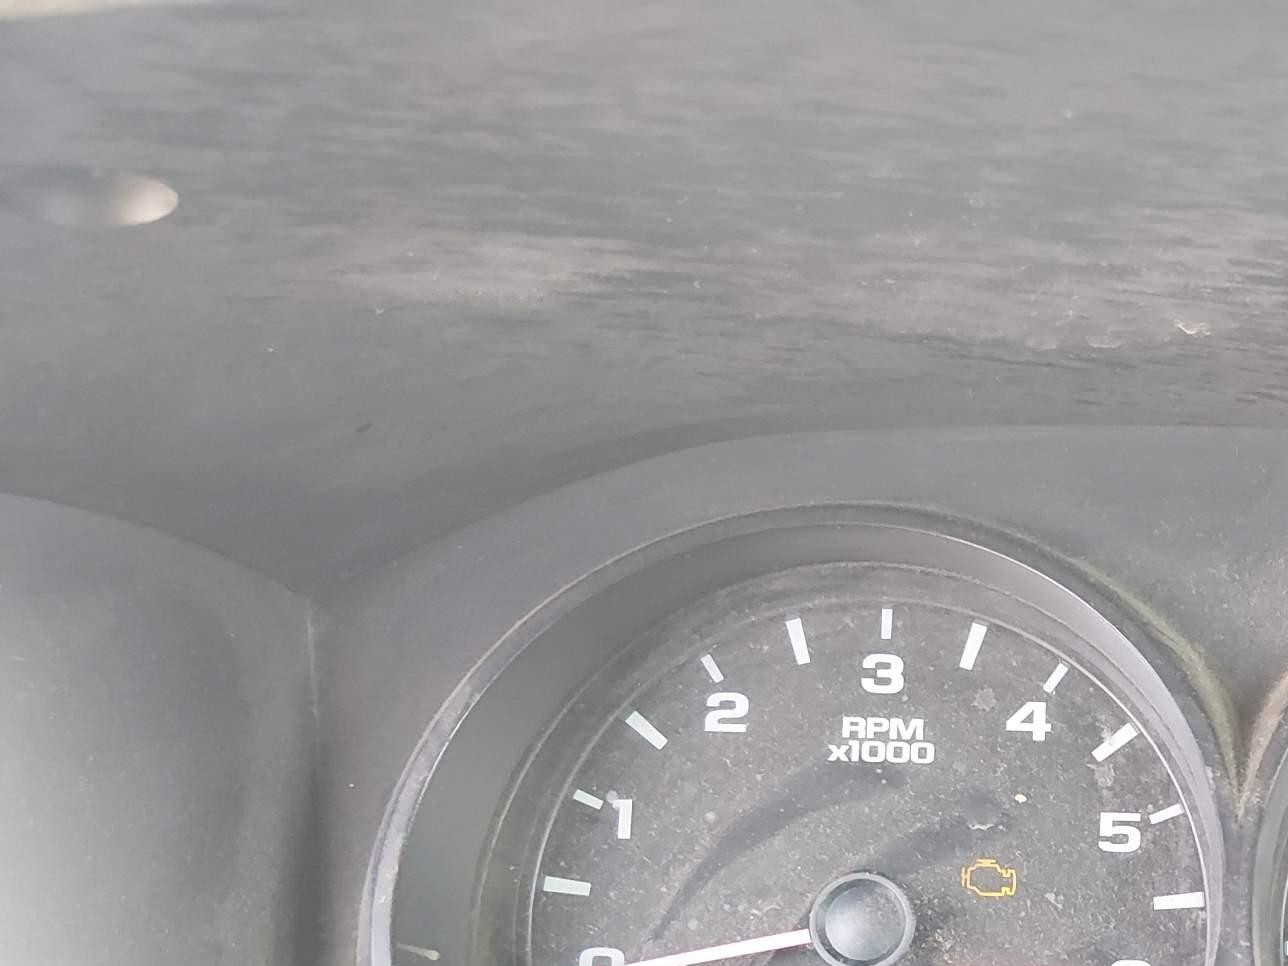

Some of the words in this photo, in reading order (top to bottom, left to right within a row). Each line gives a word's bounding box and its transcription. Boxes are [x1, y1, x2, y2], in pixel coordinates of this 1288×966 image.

[861, 654, 905, 694] 3
[704, 692, 750, 732] 2
[842, 717, 924, 740] RPM
[1005, 701, 1051, 741] 4
[827, 741, 935, 764] x1000
[611, 799, 633, 840] 1
[1098, 812, 1142, 853] 5
